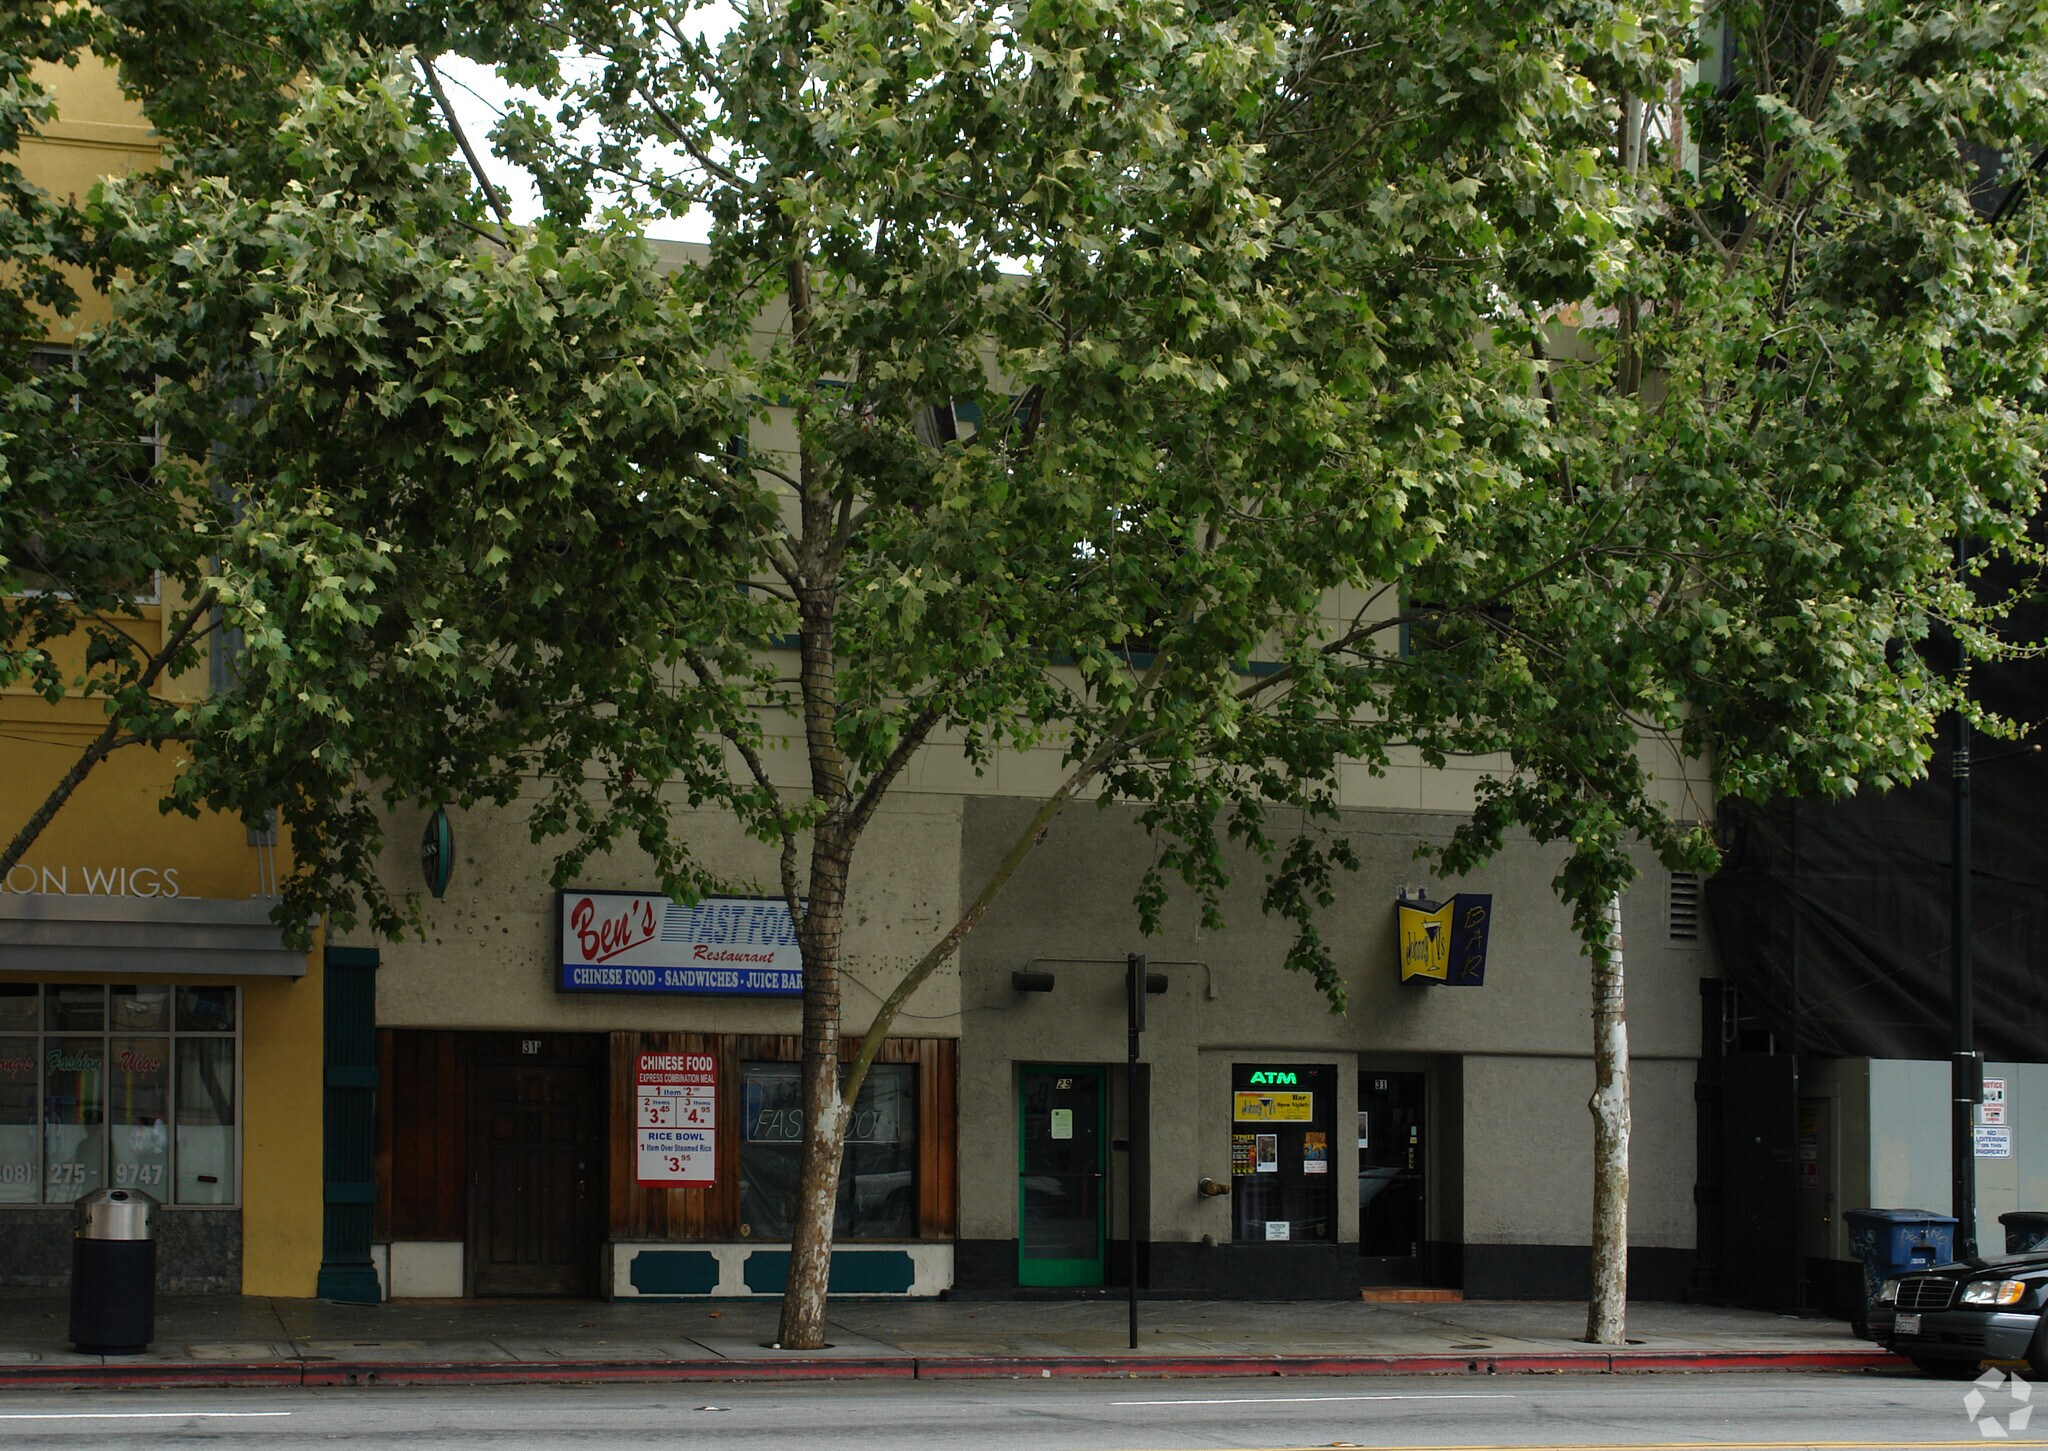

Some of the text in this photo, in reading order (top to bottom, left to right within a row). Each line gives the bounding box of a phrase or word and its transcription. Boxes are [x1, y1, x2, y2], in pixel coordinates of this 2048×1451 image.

[0, 865, 178, 898] ON WIGS
[571, 898, 656, 960] Ben's
[688, 905, 802, 945] FAST FOO
[1461, 905, 1486, 978] BAR
[693, 945, 774, 963] Restaurant
[573, 968, 804, 989] CHINESE FOOD SANDWICHES JUICE BAR
[47, 1049, 103, 1076] Fashion
[121, 1051, 161, 1079] Wigs
[641, 1056, 713, 1071] CHINESE FOOD
[639, 1073, 715, 1083] EXPRESS COMBINATION MEAL
[1056, 1079, 1072, 1089] 29
[1250, 1071, 1297, 1085] ATM
[1374, 1080, 1388, 1090] 31
[655, 1087, 661, 1096] 1
[644, 1098, 650, 1106] 2
[685, 1098, 691, 1106] 3
[753, 1109, 803, 1138] FAS
[648, 1132, 705, 1141] RICE BOWL
[640, 1143, 645, 1152] 1
[660, 1144, 674, 1152] Over
[675, 1144, 699, 1152] Steamed
[699, 1144, 712, 1152] Rice
[49, 1162, 86, 1184] 275
[115, 1162, 163, 1185] 9747
